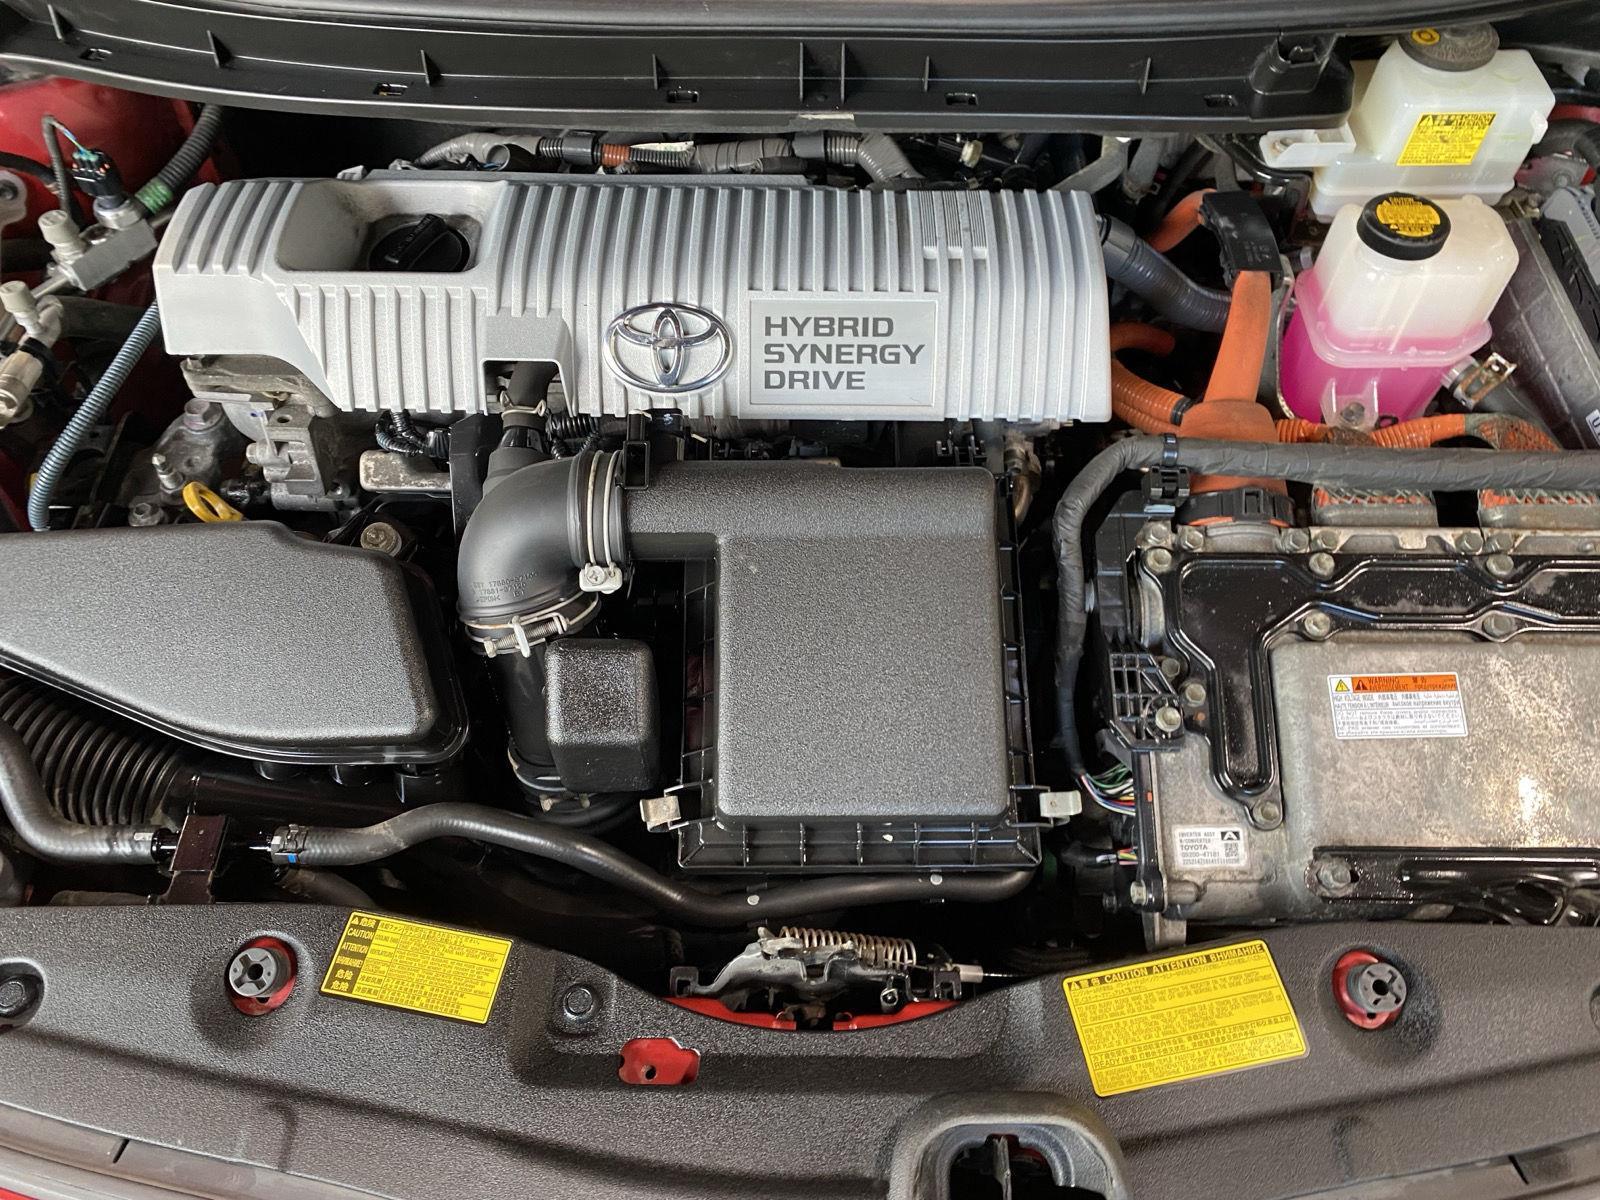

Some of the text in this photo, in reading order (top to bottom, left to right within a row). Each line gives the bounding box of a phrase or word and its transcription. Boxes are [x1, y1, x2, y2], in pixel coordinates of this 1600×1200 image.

[764, 316, 894, 337] HYBRID
[764, 343, 926, 365] SYNERGY
[764, 370, 866, 390] DRIVE
[347, 927, 375, 940] CAUTION
[342, 942, 369, 954] ATTENTION
[1209, 944, 1264, 962] ВНИМАНИЕ
[1104, 968, 1149, 983] CAUTION
[1152, 954, 1207, 975] ATTENTION
